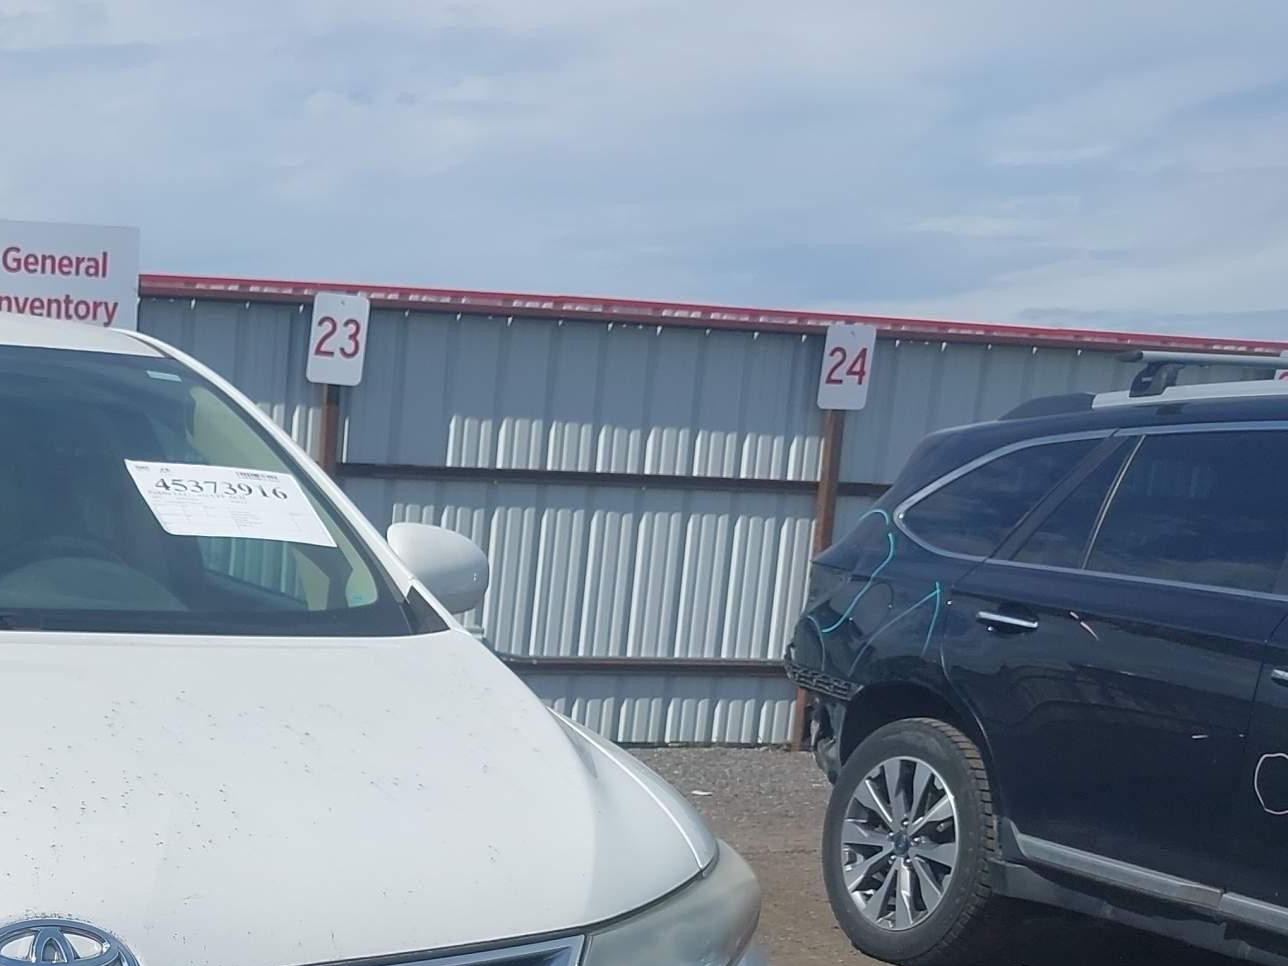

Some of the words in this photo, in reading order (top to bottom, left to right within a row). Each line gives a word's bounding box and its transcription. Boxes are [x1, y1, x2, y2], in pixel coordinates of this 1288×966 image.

[2, 246, 109, 279] General
[313, 315, 361, 360] 23
[825, 346, 868, 386] 24
[154, 477, 289, 502] 45373916
